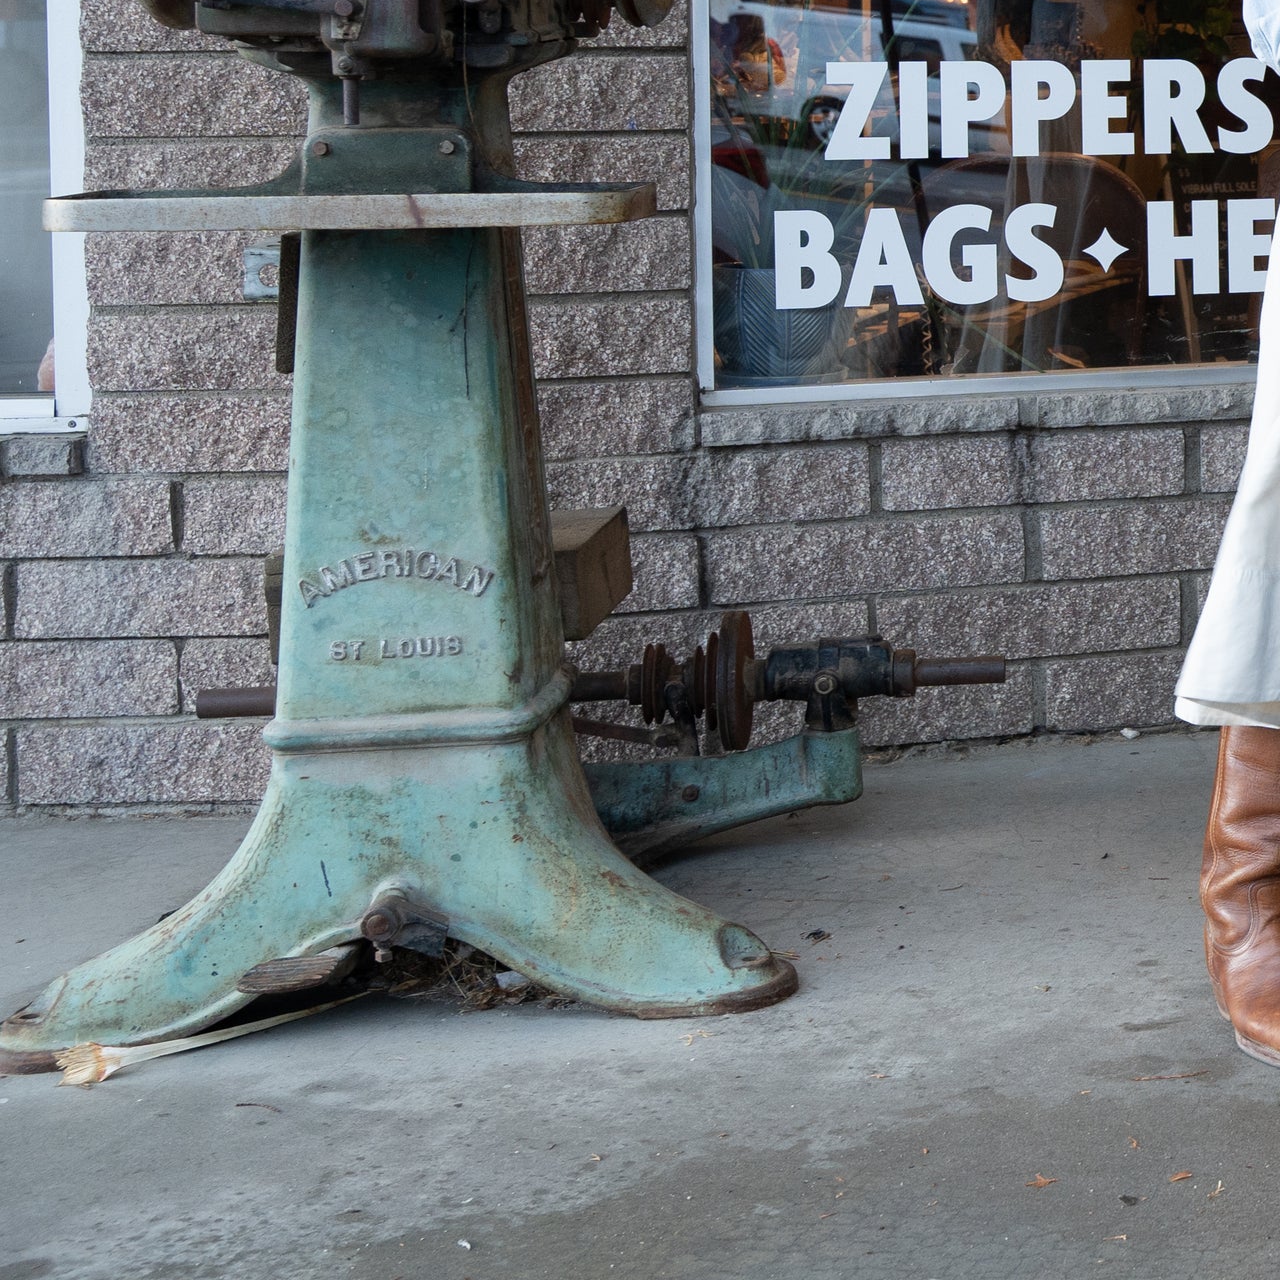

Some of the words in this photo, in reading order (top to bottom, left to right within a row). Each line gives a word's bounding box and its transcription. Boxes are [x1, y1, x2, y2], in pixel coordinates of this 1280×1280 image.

[824, 58, 1274, 161] ZIPPERS
[1214, 181, 1235, 193] FULL
[1236, 180, 1257, 192] SOLE
[774, 203, 1064, 310] BAGS
[299, 549, 494, 608] AMERICAN
[329, 639, 366, 661] ST
[380, 635, 463, 659] LOUIS
